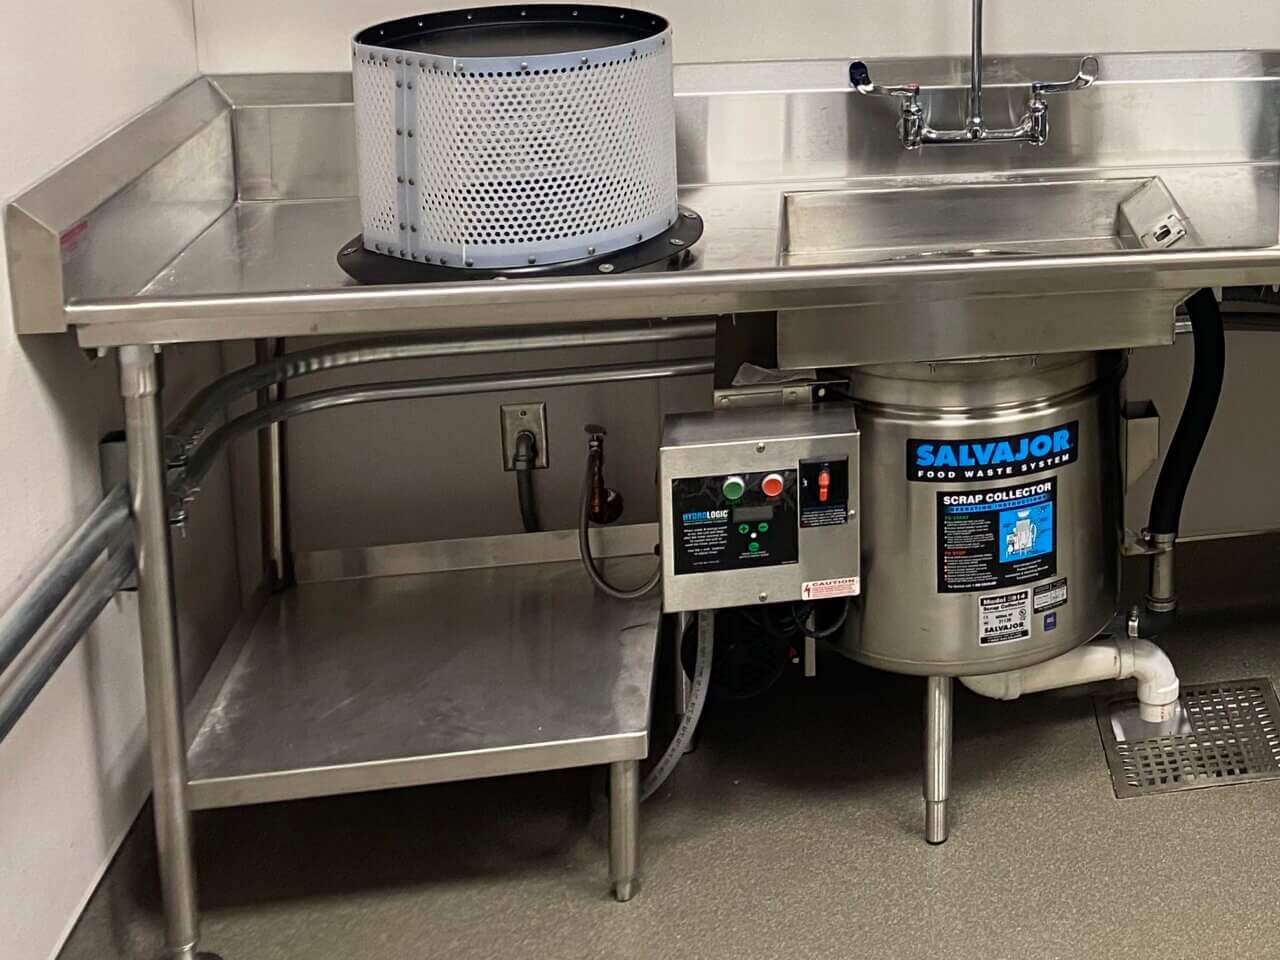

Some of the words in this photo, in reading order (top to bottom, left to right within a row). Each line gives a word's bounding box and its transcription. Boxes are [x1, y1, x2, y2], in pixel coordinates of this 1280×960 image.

[916, 428, 1070, 467] SALVAJOR
[918, 470, 956, 479] FOOD
[965, 466, 1013, 478] WASTE
[1021, 454, 1070, 472] SYSTEM
[943, 494, 983, 505] SCRAP
[986, 482, 1052, 502] COLLECTOR
[984, 621, 1025, 634] SALVAJOR
